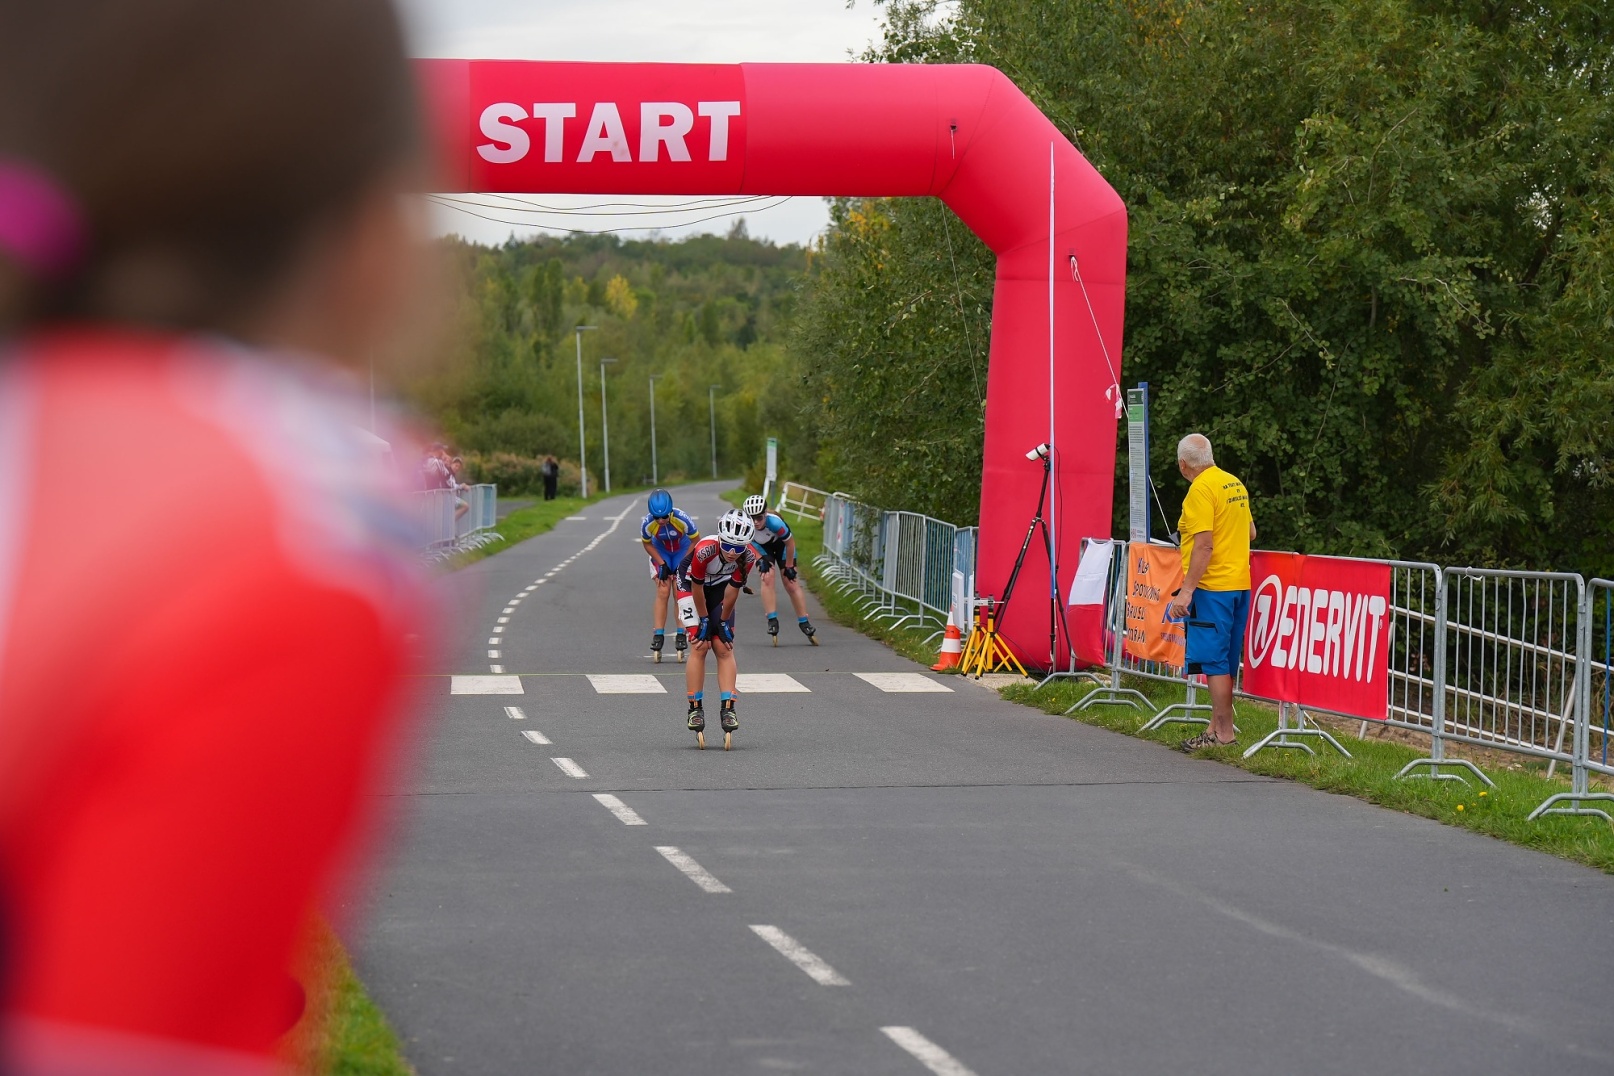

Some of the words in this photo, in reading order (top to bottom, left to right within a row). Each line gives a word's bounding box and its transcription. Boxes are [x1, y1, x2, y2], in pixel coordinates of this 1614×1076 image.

[476, 101, 741, 164] START
[683, 607, 694, 620] 21
[1271, 585, 1386, 684] ENERVIT
